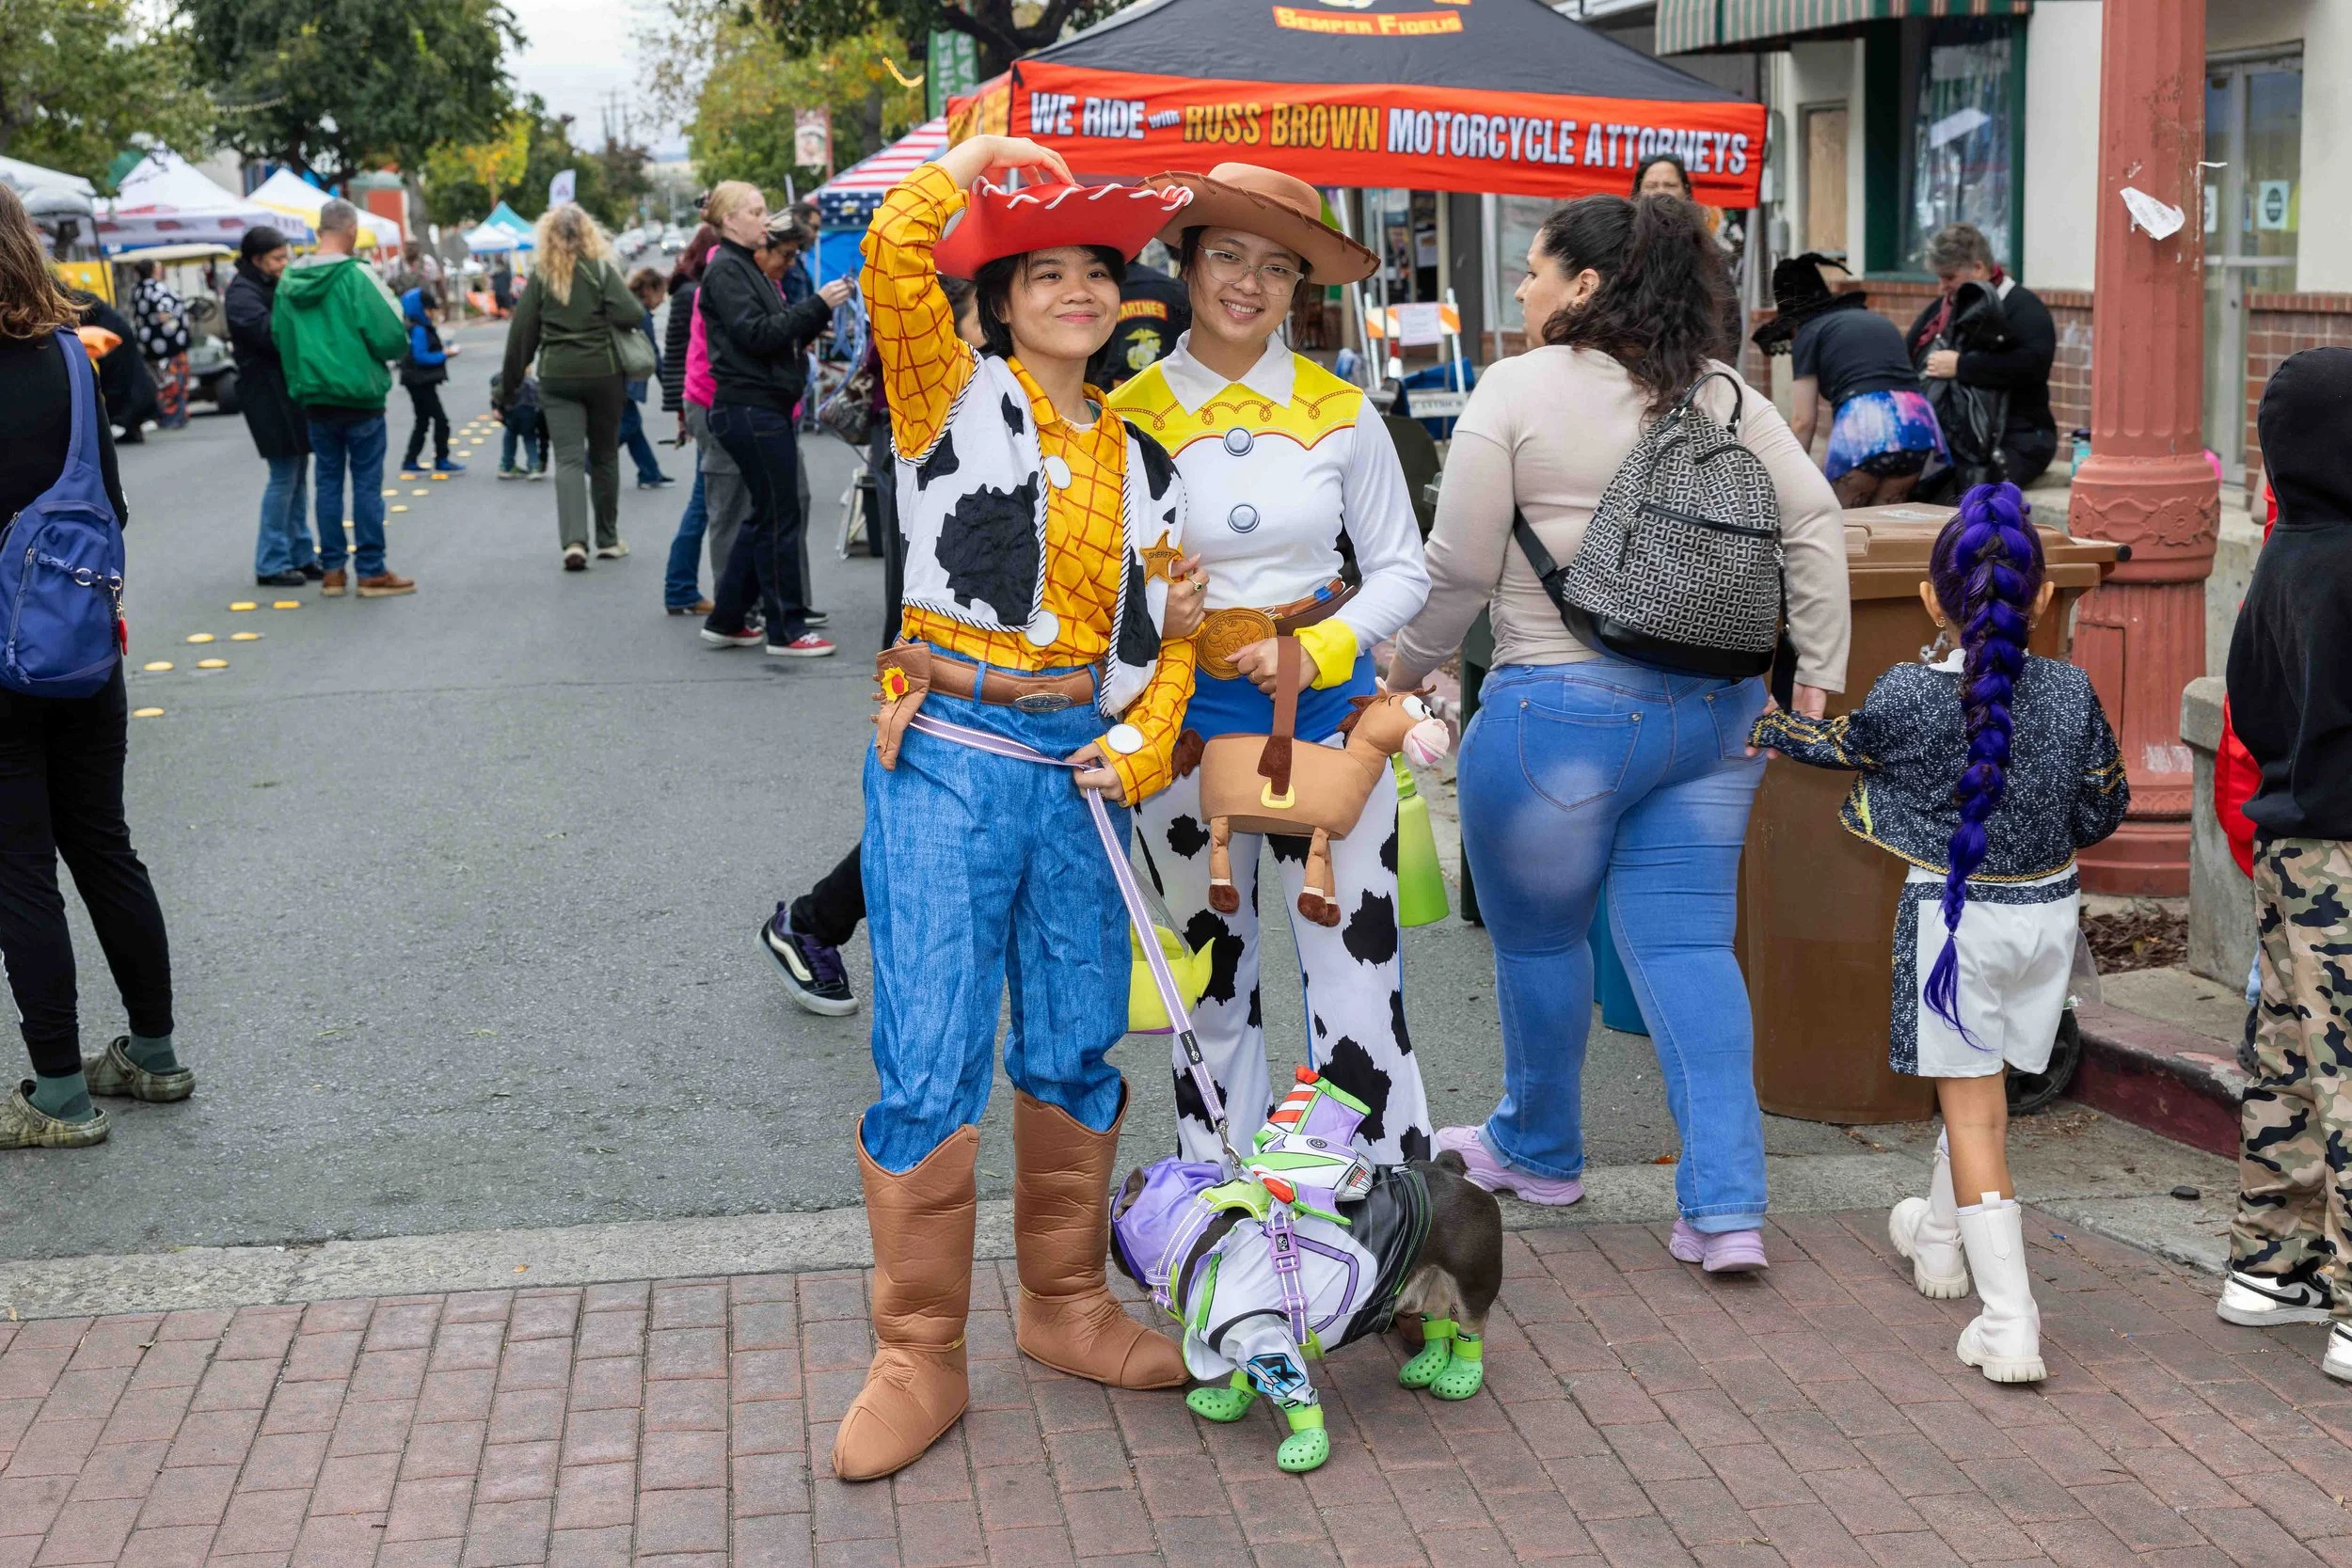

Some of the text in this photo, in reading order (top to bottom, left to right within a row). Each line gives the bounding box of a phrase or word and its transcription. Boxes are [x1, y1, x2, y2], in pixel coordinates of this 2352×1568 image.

[1030, 91, 1076, 135] WE
[1082, 96, 1146, 139] RIDE
[1148, 109, 1181, 129] with
[1184, 103, 1263, 145] RUSS
[1270, 102, 1380, 151] BROWN
[1387, 107, 1578, 165] MOTORCYCLE
[1582, 121, 1749, 175] ATTORNEYS
[1148, 550, 1171, 559] SHERIFF
